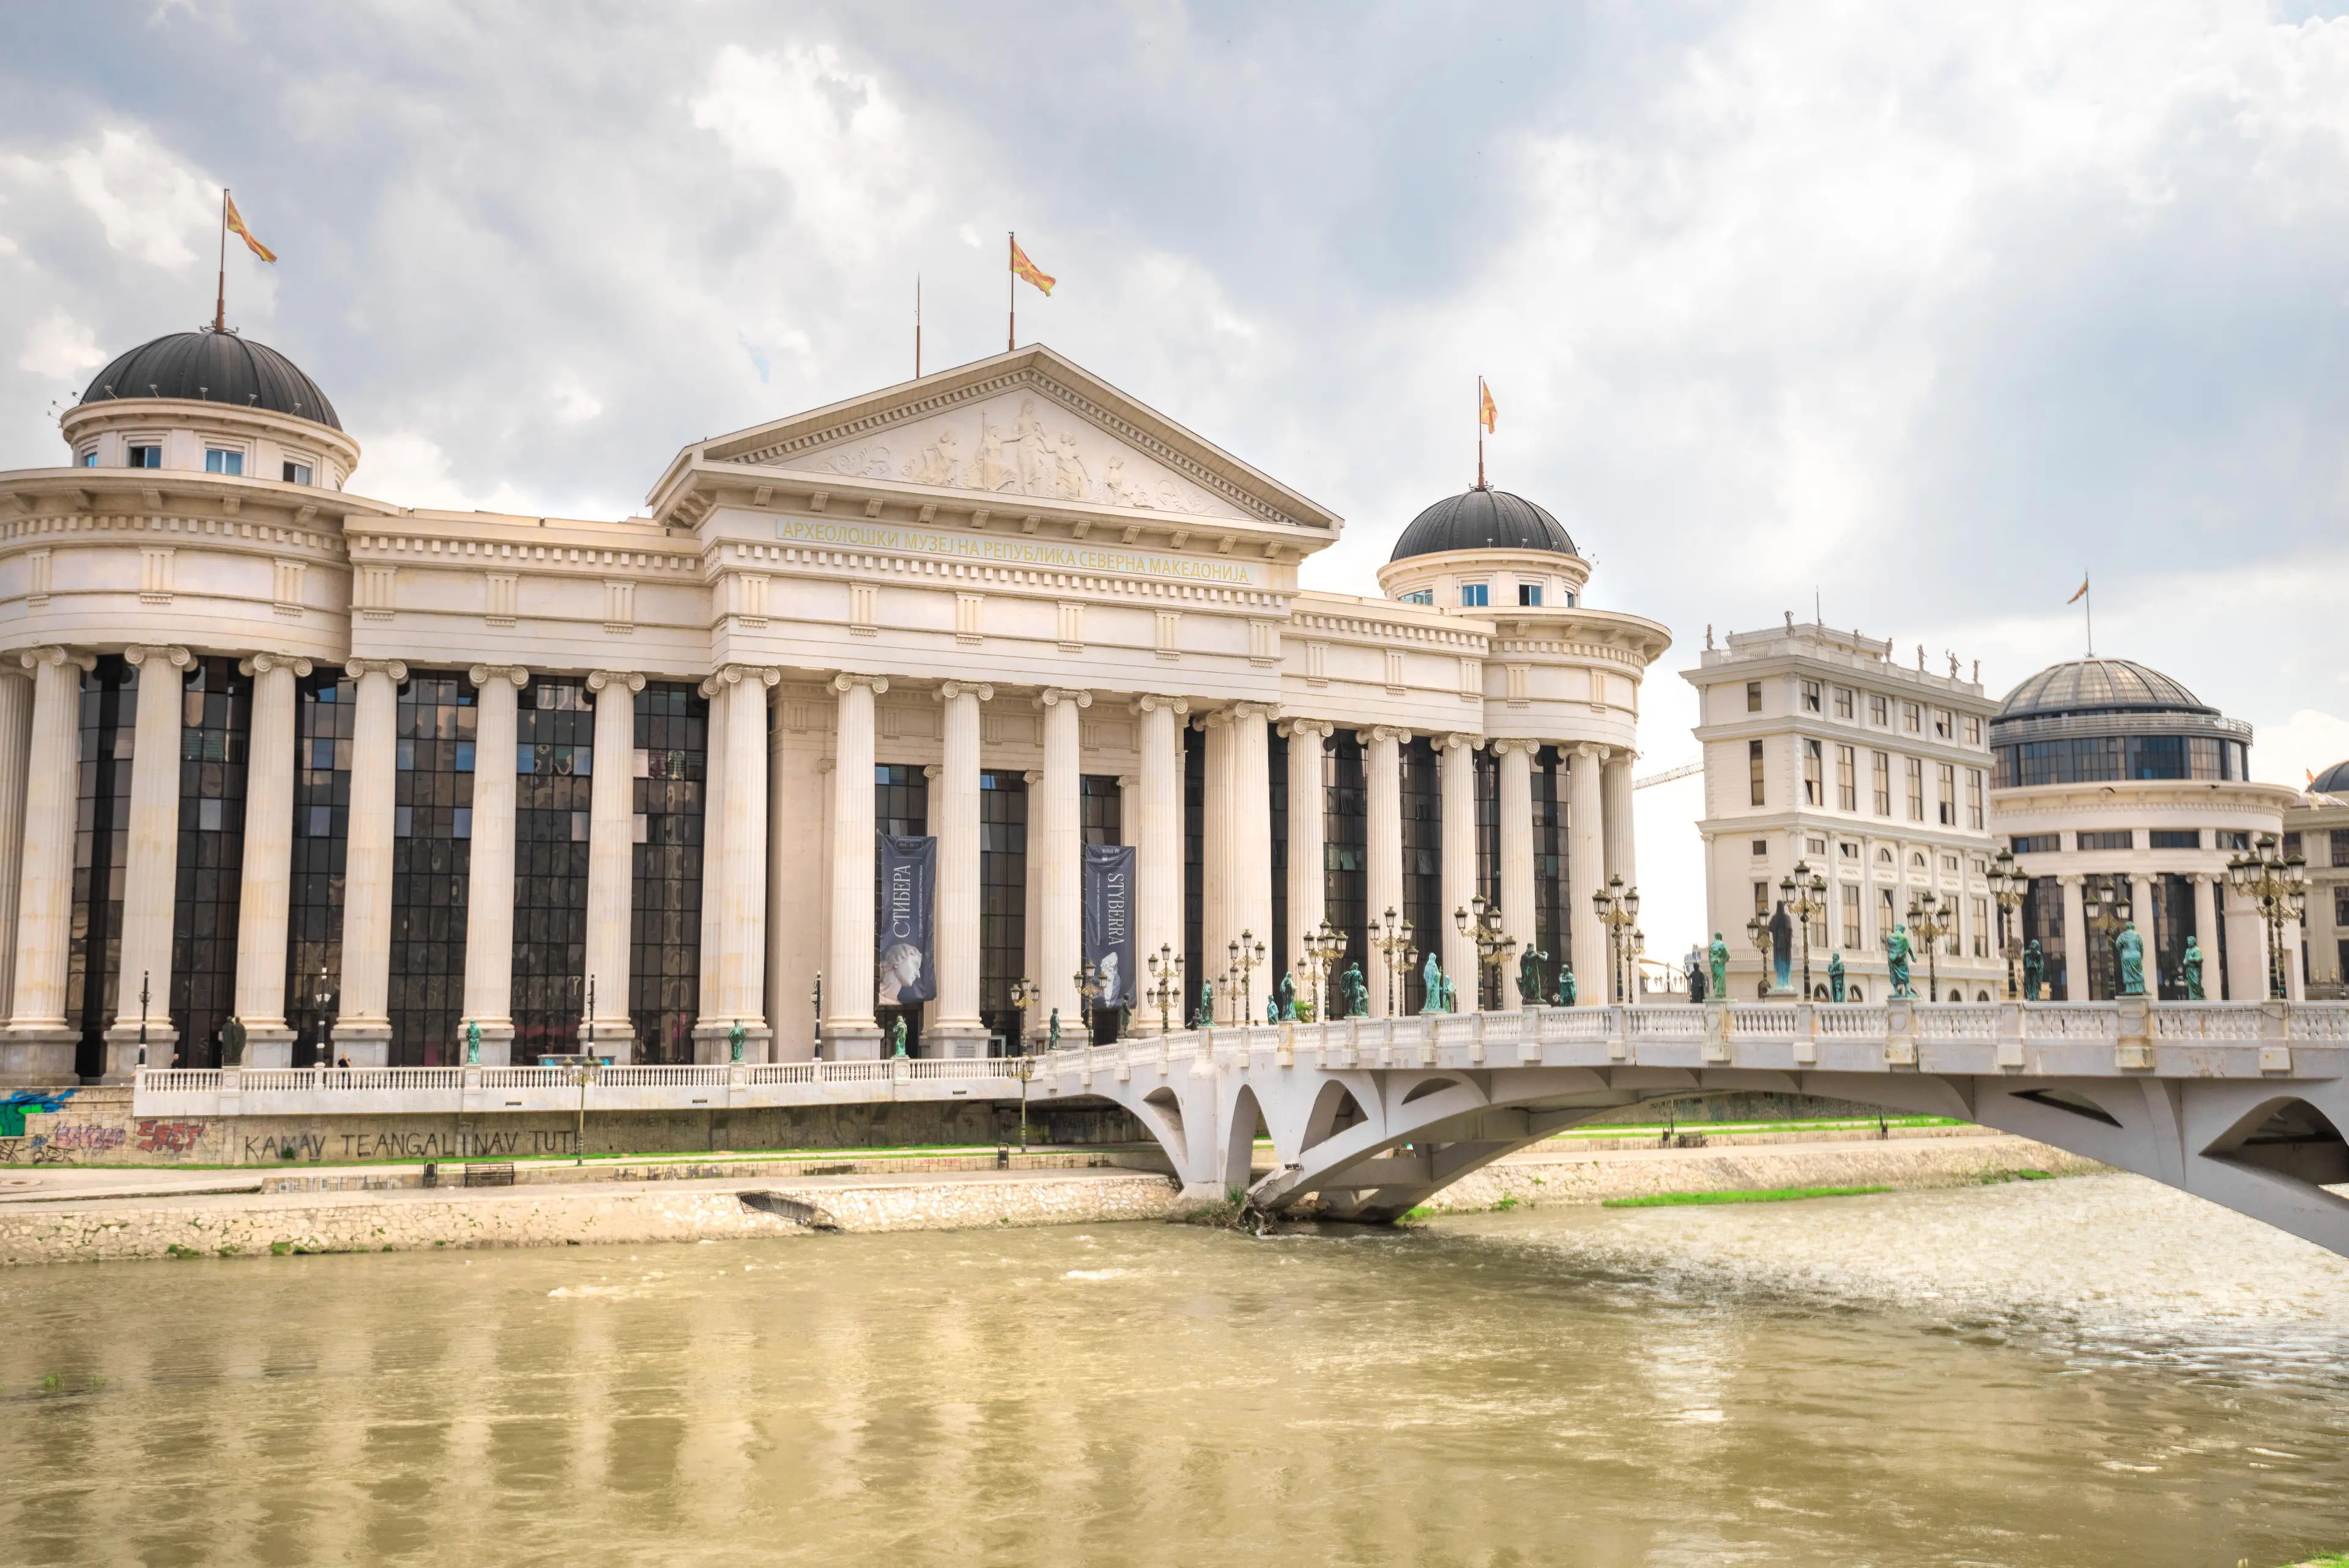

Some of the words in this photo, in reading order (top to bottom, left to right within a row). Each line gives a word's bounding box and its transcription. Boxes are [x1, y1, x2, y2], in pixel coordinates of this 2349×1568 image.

[782, 521, 899, 548] АРХЕОЛОШКИ
[904, 533, 954, 554] МУЗЕЈ
[958, 538, 979, 556] НА
[984, 541, 1076, 566] РЕПУБЛИКА
[1079, 551, 1146, 573] СЕВЕРНА
[1149, 557, 1249, 582] МАКЕДОНИЈА
[893, 864, 911, 938] СТИБЕРА
[1108, 873, 1125, 946] STYBERRA
[245, 1132, 325, 1161] KAMAV
